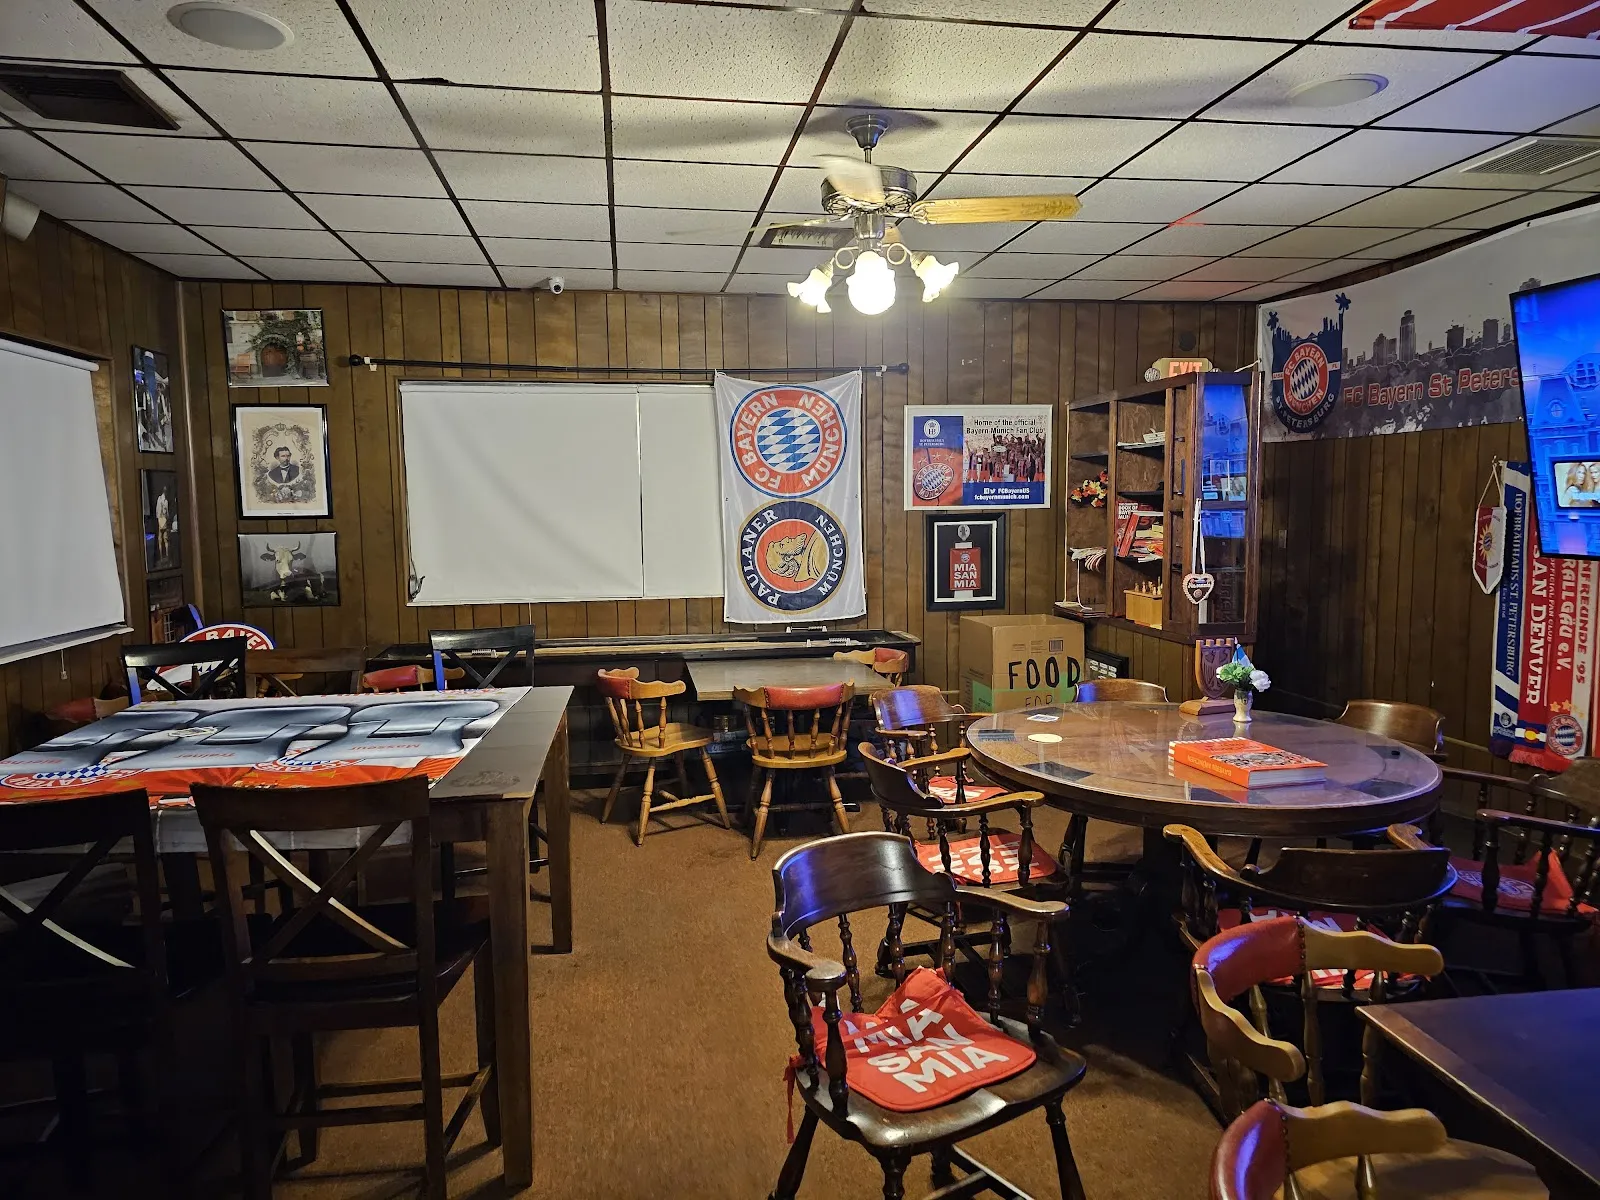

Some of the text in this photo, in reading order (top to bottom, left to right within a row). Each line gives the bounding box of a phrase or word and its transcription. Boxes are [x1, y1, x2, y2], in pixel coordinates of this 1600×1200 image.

[1168, 361, 1203, 377] EXIT
[1285, 346, 1325, 376] FC BAYERN
[1343, 385, 1364, 408] FC
[1367, 381, 1424, 410] Bayern
[1428, 373, 1453, 398] St
[737, 393, 781, 490] FC BAYERN
[798, 393, 840, 487] MÜNCHEN
[966, 427, 987, 435] Bayern
[814, 514, 844, 596] MÜNCHEN
[1510, 493, 1523, 580] HOFBRÄUHAUS
[742, 509, 781, 606] PAULANER
[953, 571, 978, 579] SAN
[954, 563, 977, 571] MIA
[954, 580, 977, 588] MIA
[1505, 602, 1519, 676] PETERSBURG
[1525, 603, 1546, 704] DENVER
[1008, 656, 1081, 690] FOOD
[1556, 645, 1571, 671] e.V.
[352, 742, 420, 751] Masseur
[867, 1022, 976, 1074] SAN
[892, 1046, 1011, 1094] MIA
